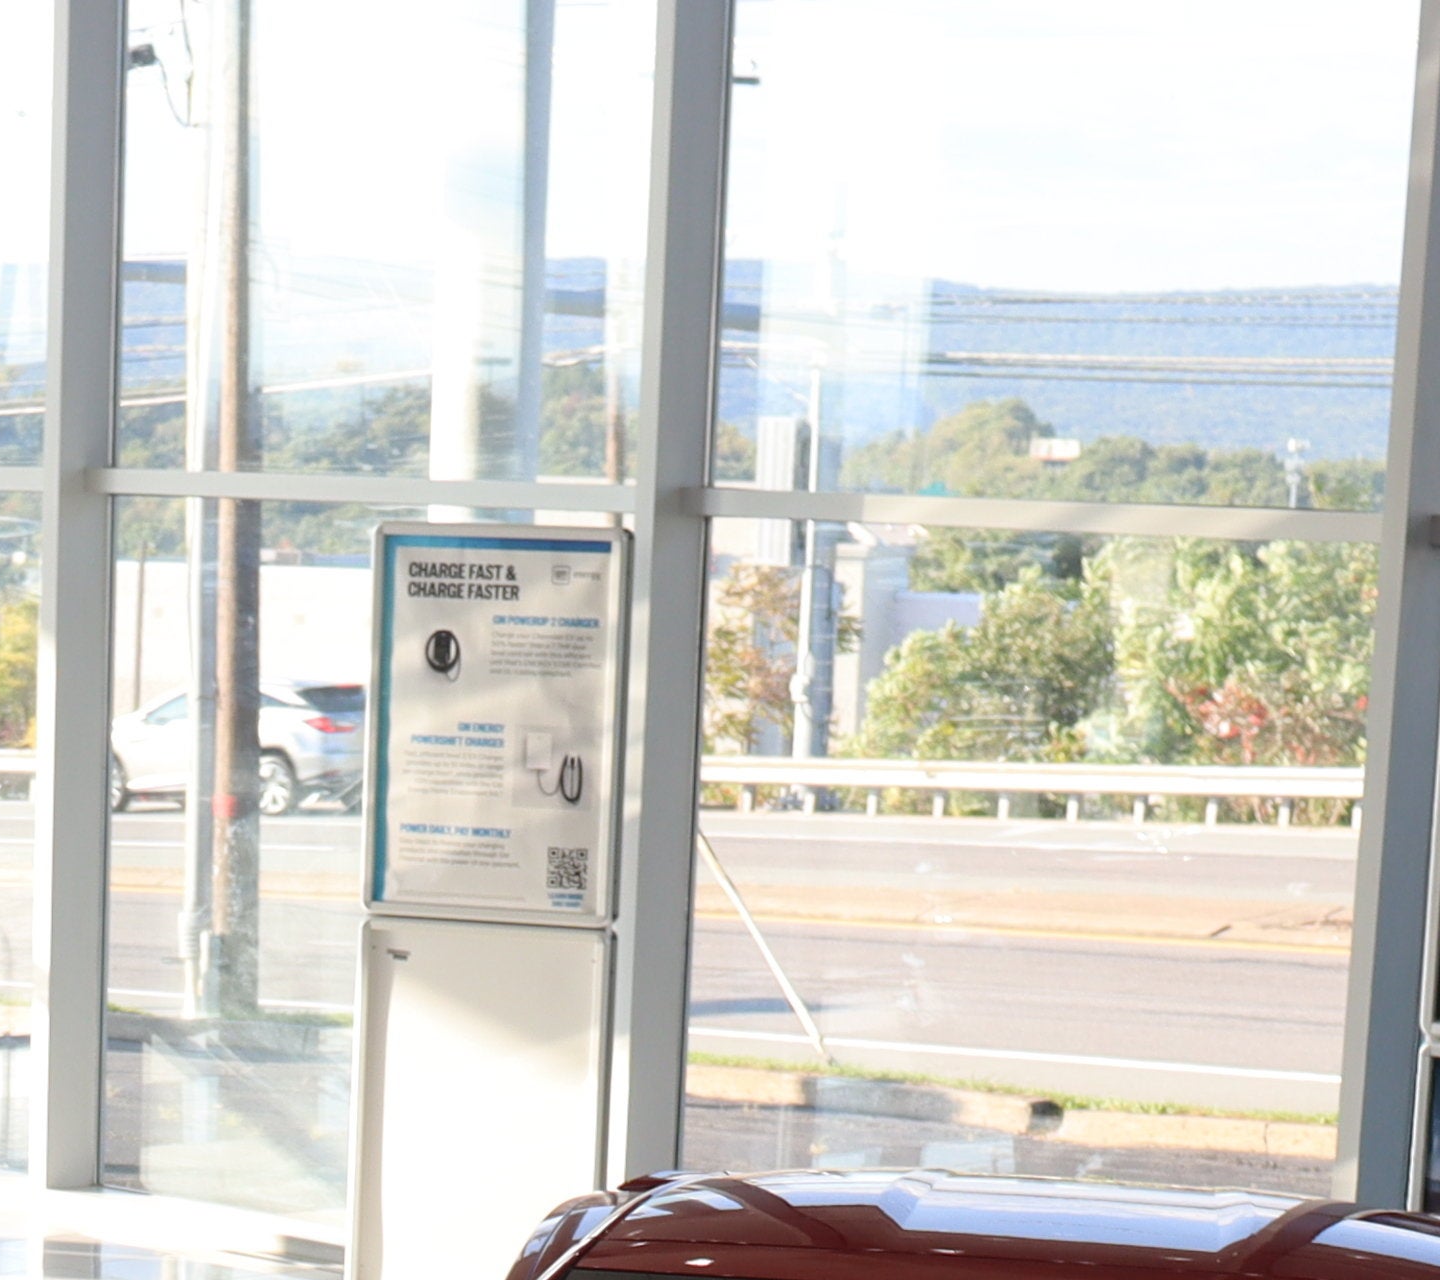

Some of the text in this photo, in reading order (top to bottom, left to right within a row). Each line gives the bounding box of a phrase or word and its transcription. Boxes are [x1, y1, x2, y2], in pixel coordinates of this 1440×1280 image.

[409, 562, 517, 581] CHARGE FAST &
[408, 582, 519, 600] CHARGE FASTER
